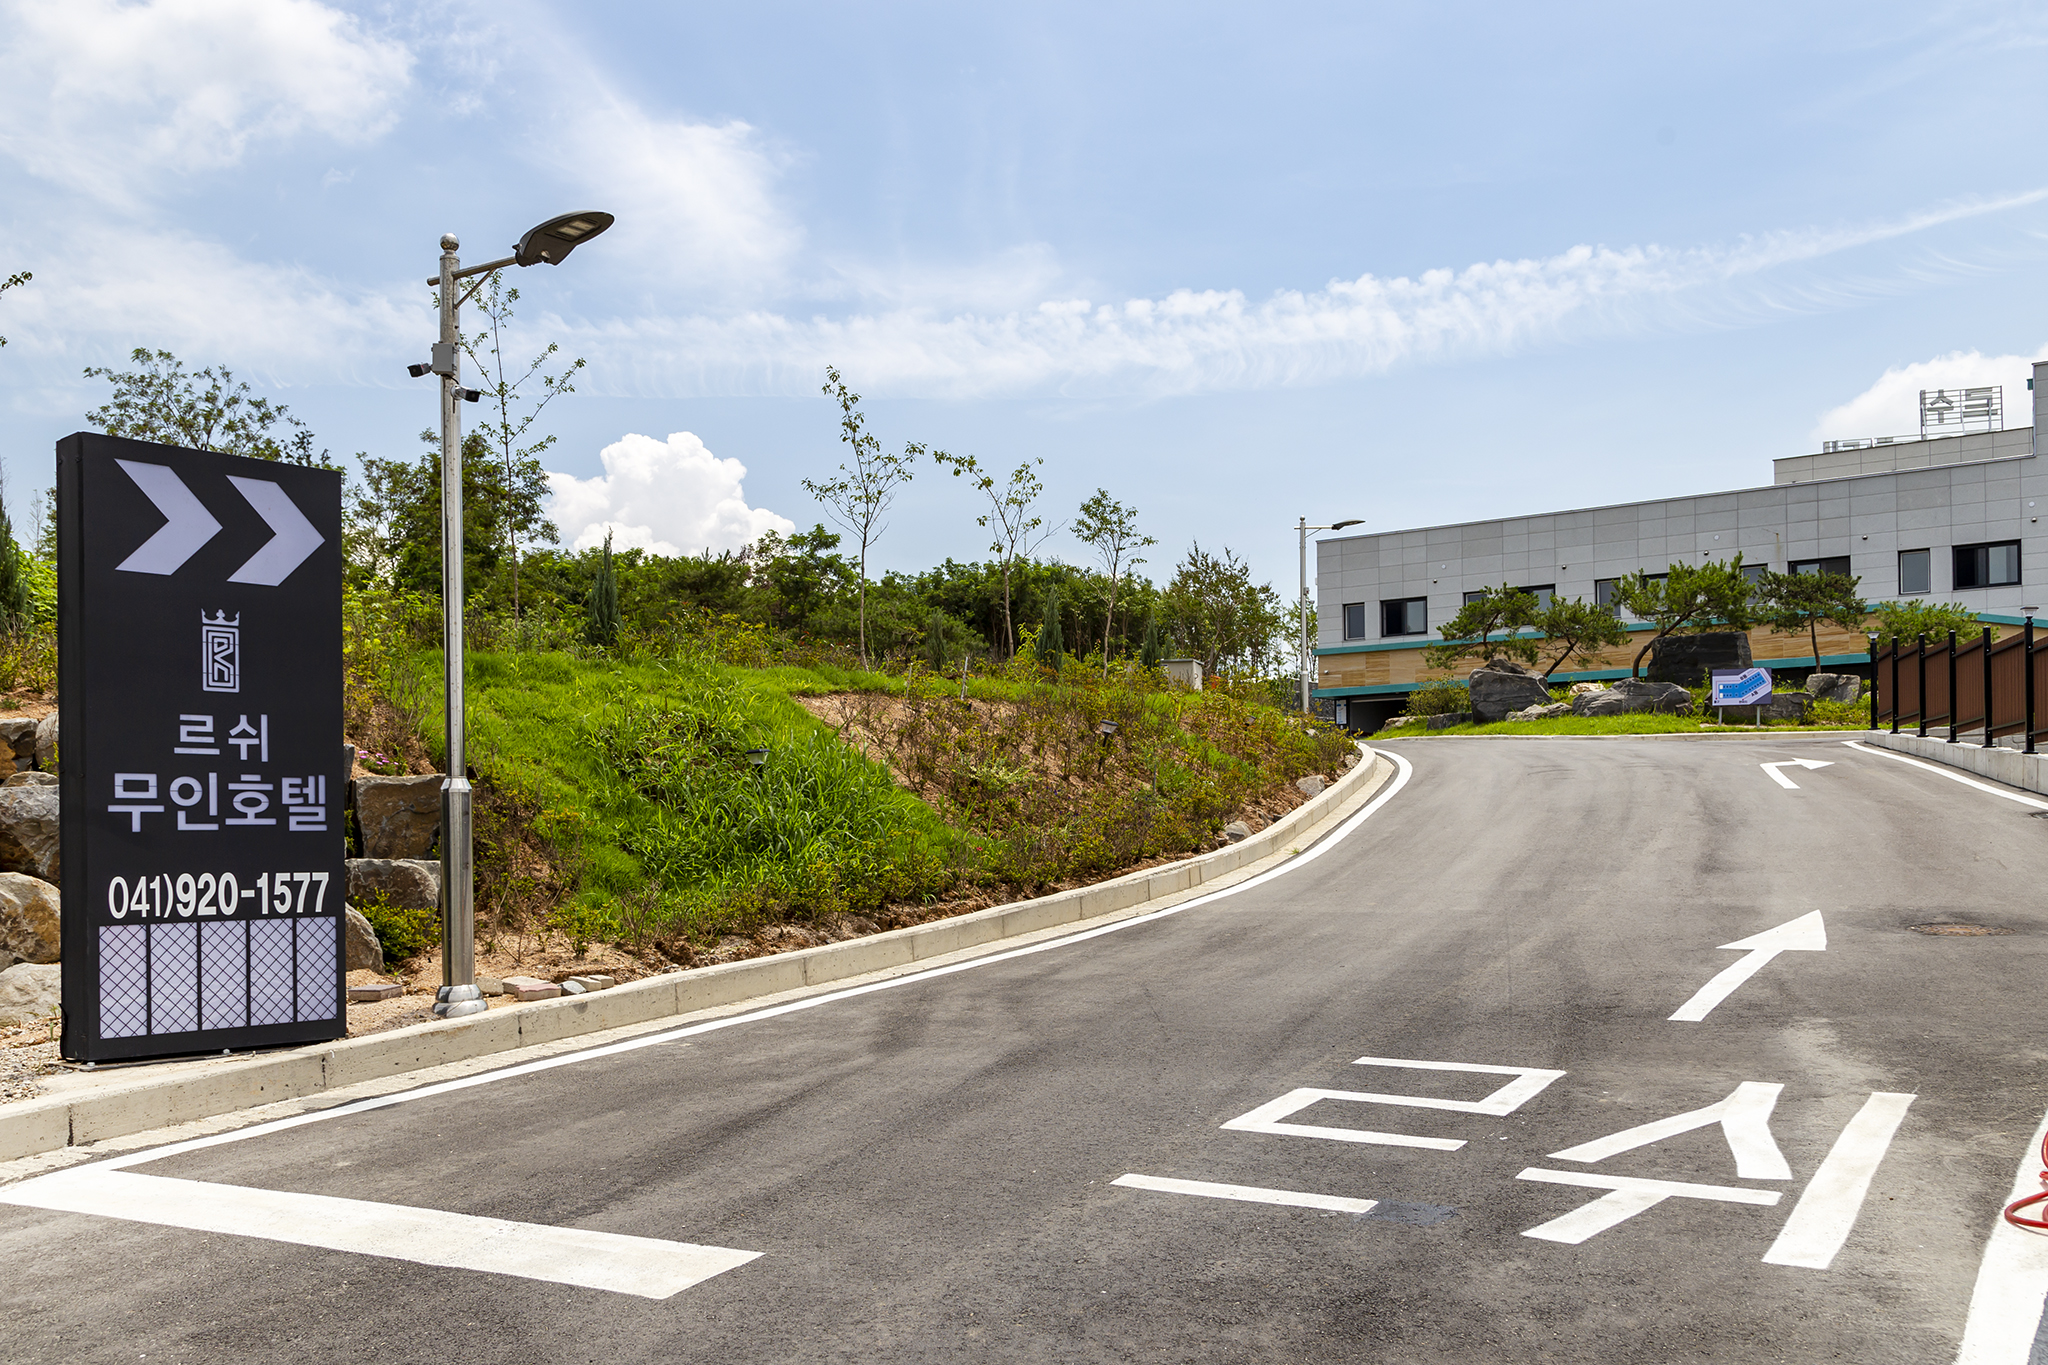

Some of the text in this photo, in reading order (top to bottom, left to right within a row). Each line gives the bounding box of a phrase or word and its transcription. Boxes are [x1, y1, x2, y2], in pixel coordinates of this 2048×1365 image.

[174, 714, 268, 762] 르쉬
[107, 772, 328, 833] 무인호텔
[108, 871, 330, 919] 041)920-1577
[1110, 1056, 1918, 1269] 르쉬
